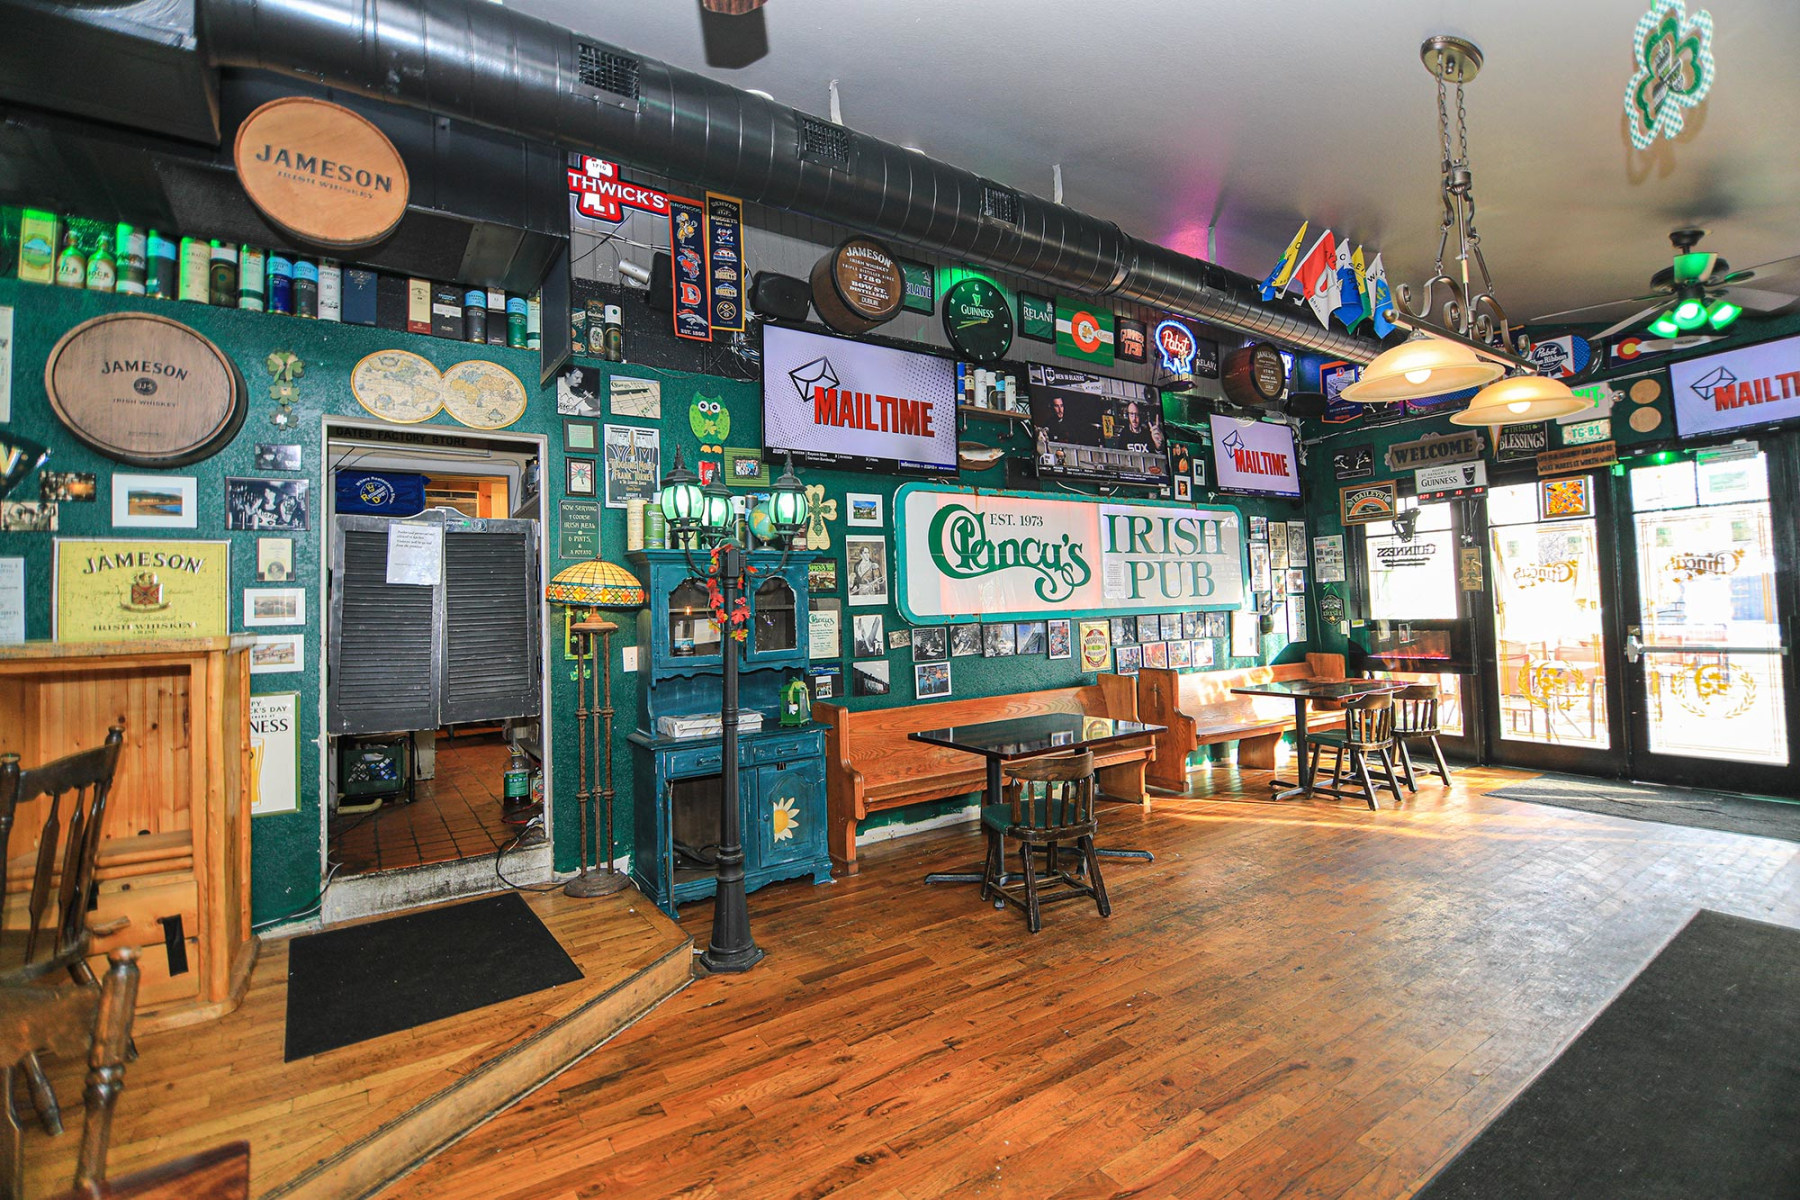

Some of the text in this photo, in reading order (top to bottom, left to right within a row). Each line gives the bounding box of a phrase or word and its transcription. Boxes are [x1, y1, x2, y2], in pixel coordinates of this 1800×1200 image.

[256, 144, 392, 192] JAMESON
[710, 215, 738, 224] NUGGETS
[846, 247, 891, 267] JAMESON
[859, 274, 882, 284] 1780
[961, 304, 995, 319] GUINNESS
[1162, 330, 1190, 356] Pabst
[1536, 346, 1558, 358] Pabst
[101, 360, 188, 381] JAMESON
[814, 385, 936, 437] MAILTIME
[377, 430, 426, 444] FACTORY
[432, 435, 467, 447] STORE
[1127, 443, 1149, 453] SOX
[1500, 431, 1545, 450] BLESSINGS
[1394, 439, 1473, 464] WELCOME
[1234, 448, 1290, 477] MAILTIME
[1421, 476, 1458, 487] GUINNESS
[1354, 490, 1385, 502] BAILEYS
[990, 514, 1044, 527] EST. 1973
[1103, 514, 1227, 556] IRISH
[928, 503, 1091, 603] Clancy's
[83, 552, 205, 575] JAMESON
[1125, 561, 1215, 599] PUB
[93, 622, 194, 632] IRISH WHISKEY
